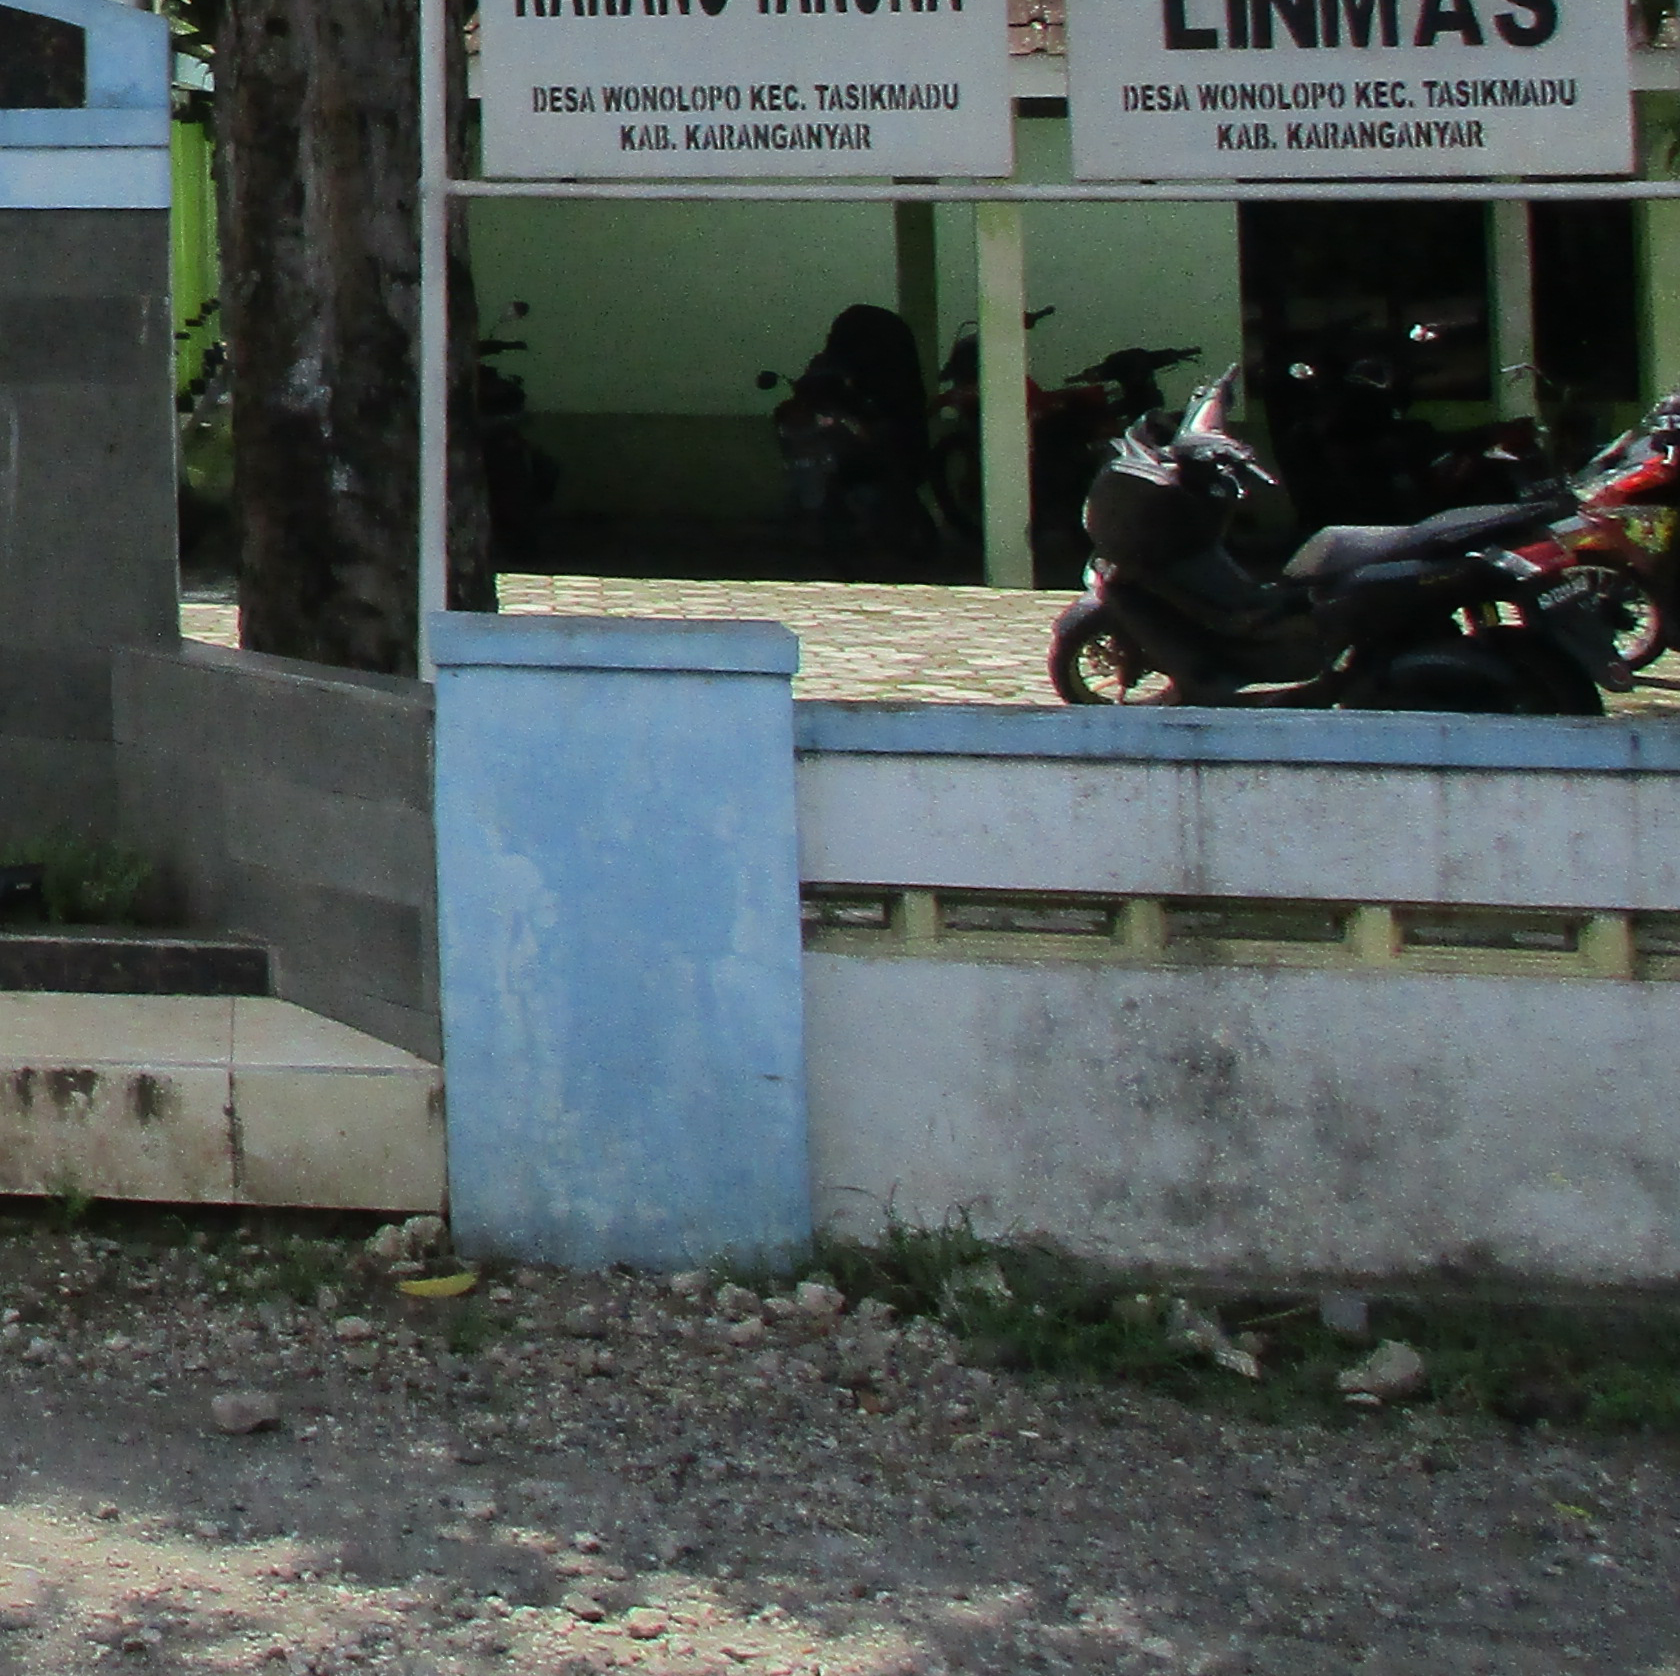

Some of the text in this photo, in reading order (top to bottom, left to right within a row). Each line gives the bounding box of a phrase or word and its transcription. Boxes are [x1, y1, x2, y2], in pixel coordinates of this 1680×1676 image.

[532, 83, 959, 113] DESA WONOLOPO KEC. TASIKMADU
[1123, 78, 1577, 112] DESA WONOLOPO KEC. TASIKMADU
[620, 123, 871, 151] KAB. KARANGANYAR
[1217, 120, 1484, 150] KAB. KARANGANYAR
